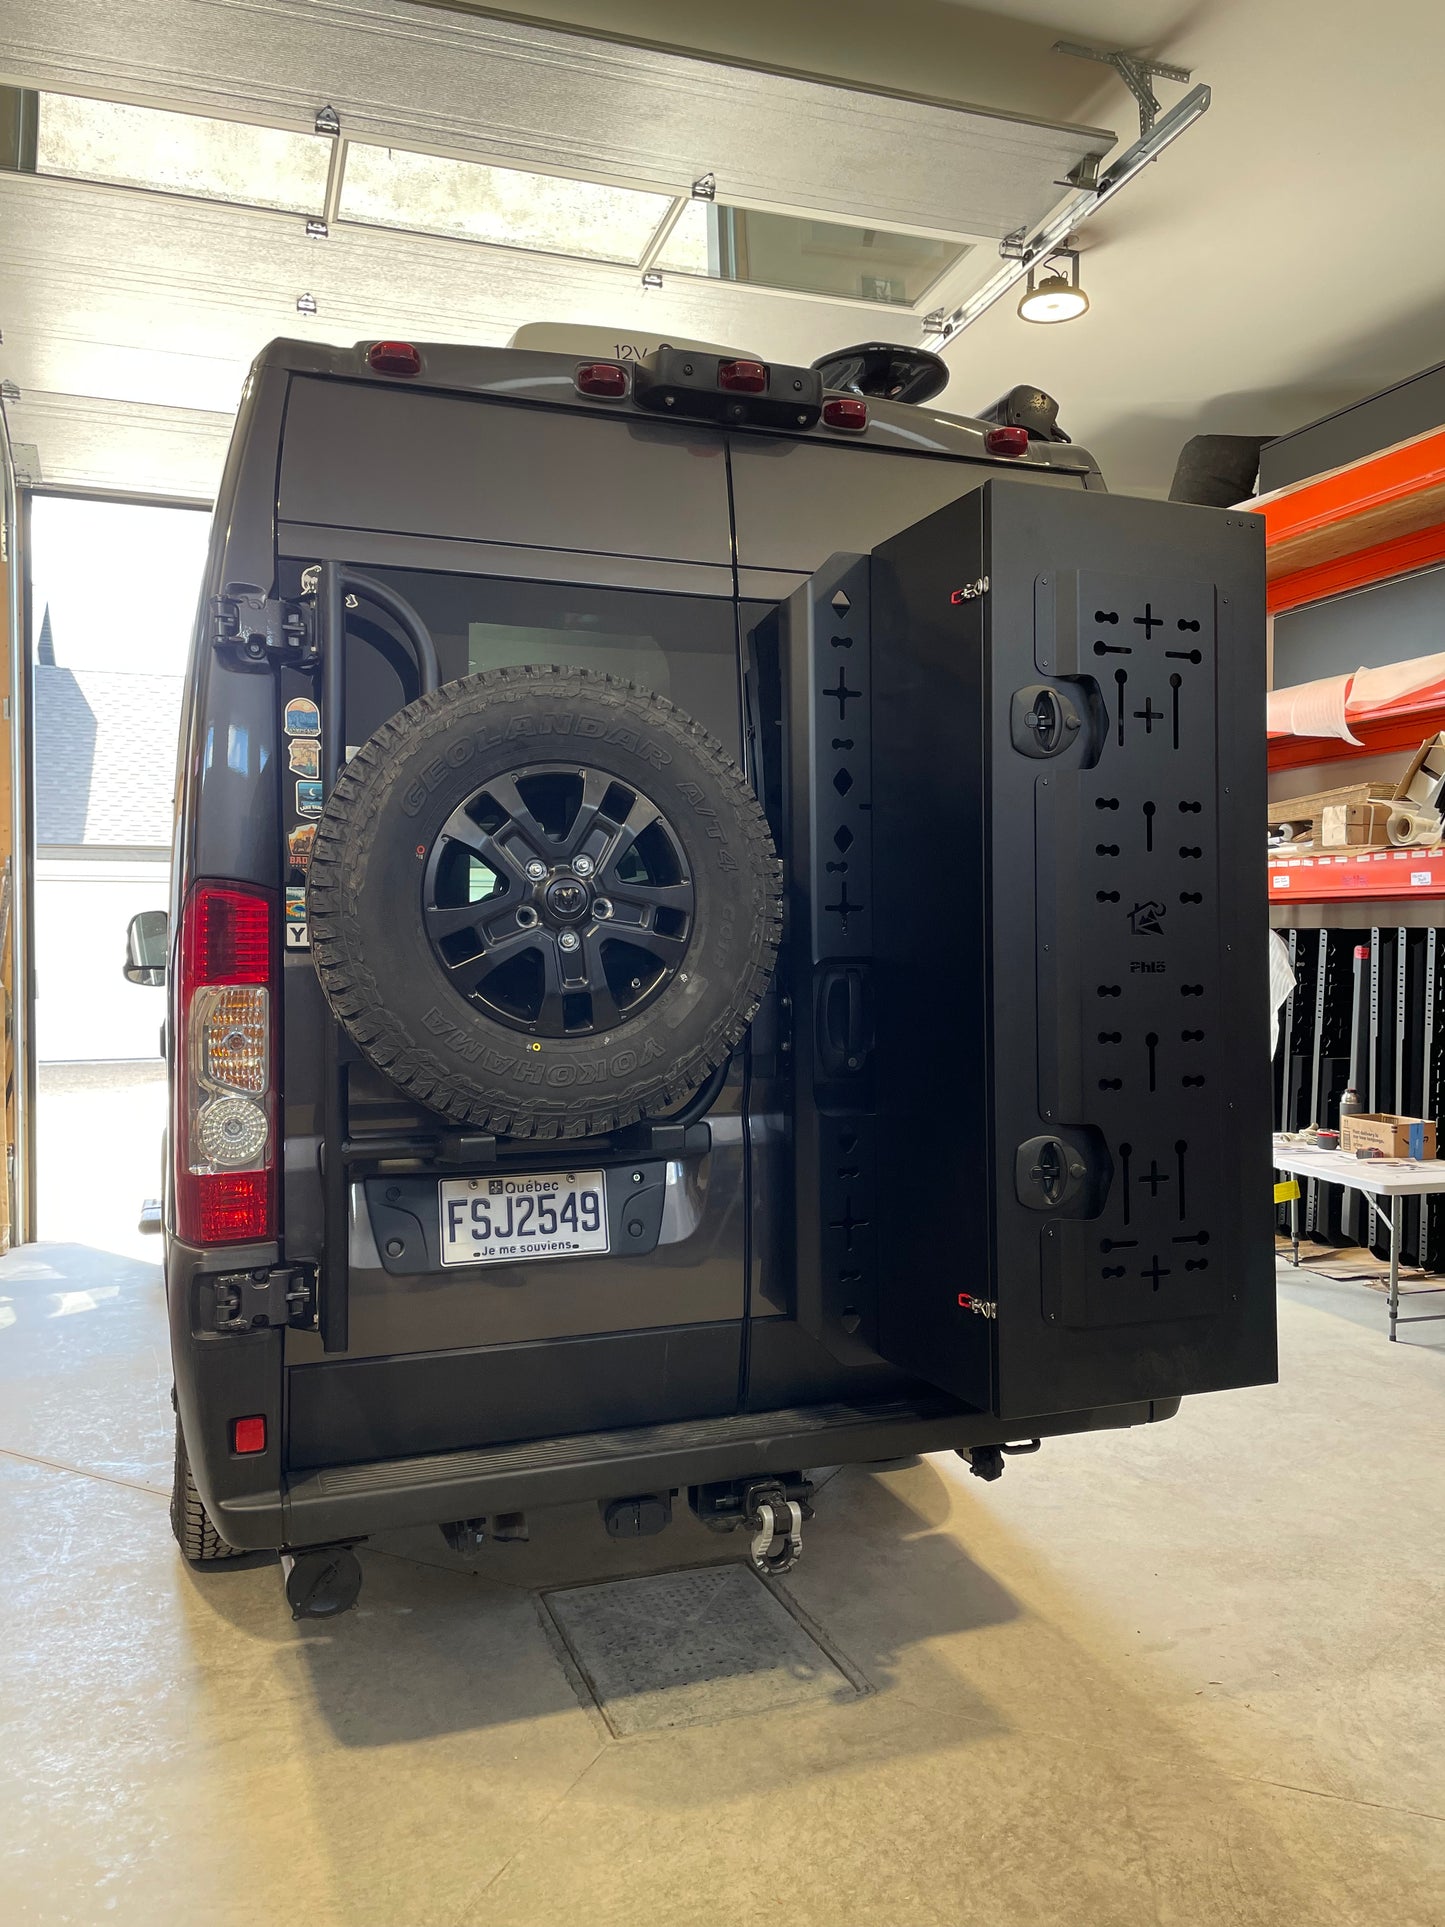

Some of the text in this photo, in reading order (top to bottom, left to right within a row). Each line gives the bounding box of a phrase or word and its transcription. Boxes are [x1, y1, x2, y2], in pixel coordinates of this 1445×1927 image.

[613, 344, 648, 361] 12V
[400, 712, 673, 818] GEOLANDAR
[1129, 960, 1167, 974] Phlö
[420, 1005, 667, 1088] YOKOHAMA
[505, 1179, 560, 1194] Québec
[447, 1190, 601, 1243] FSJ2549
[482, 1240, 572, 1256] Je me souviens
